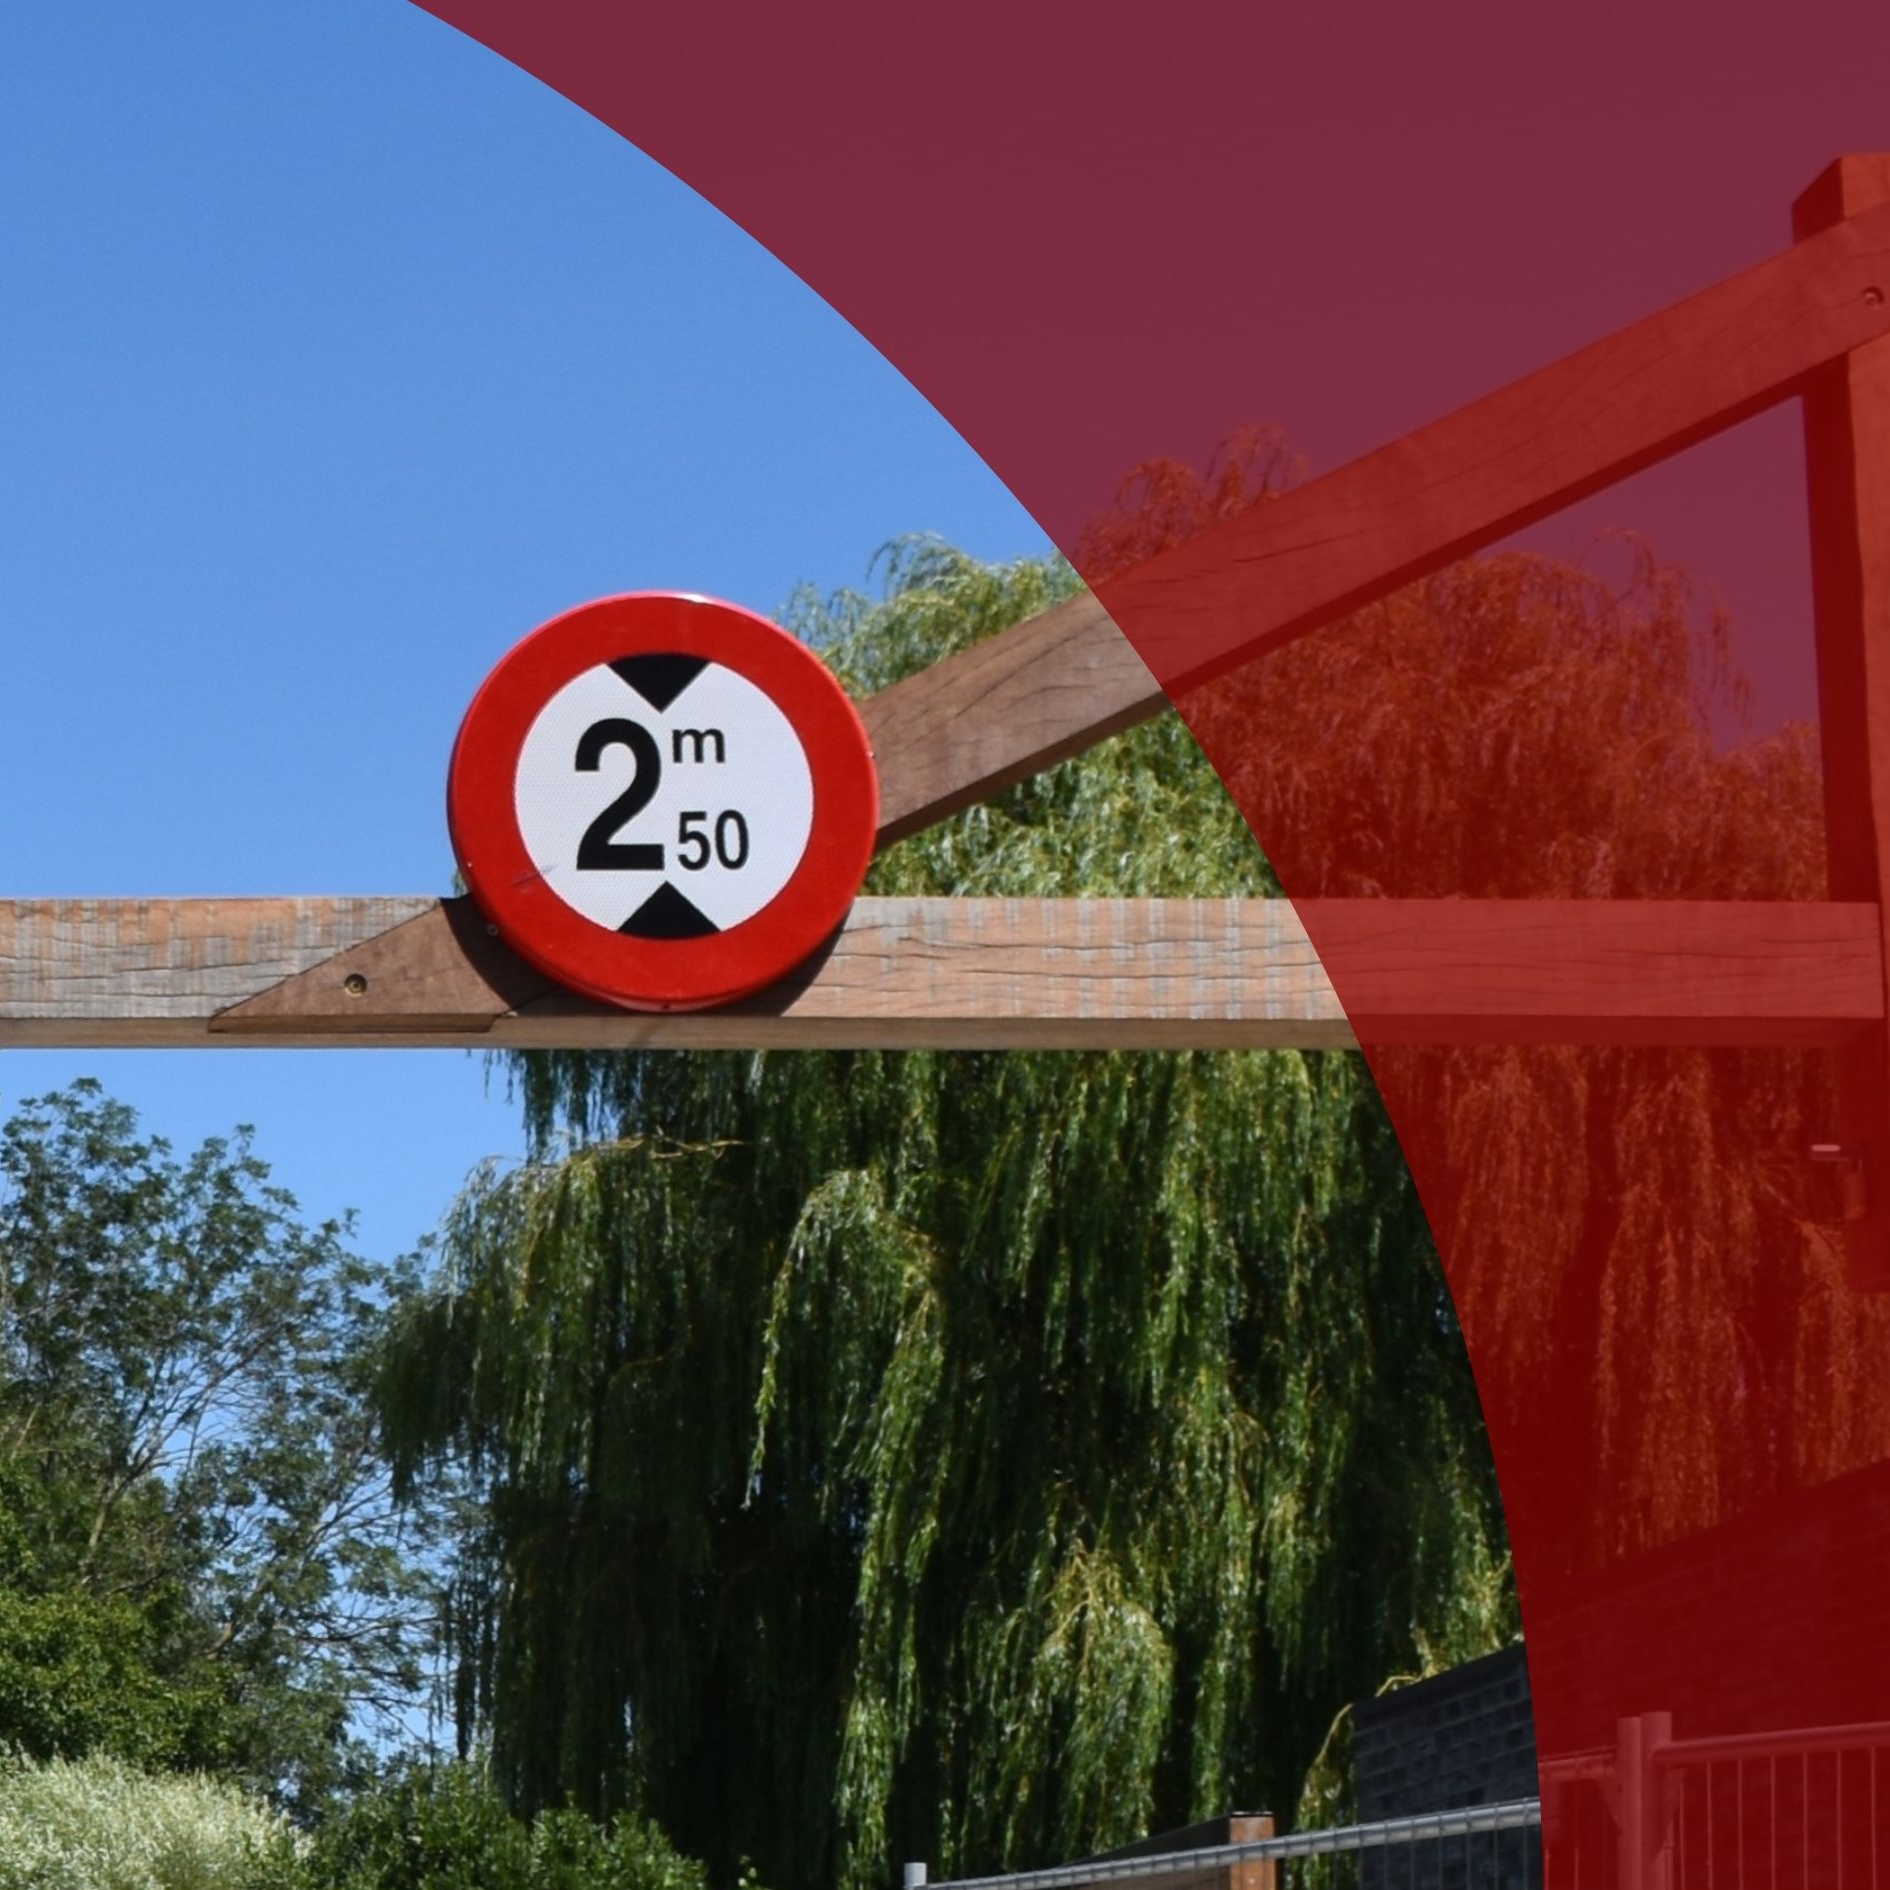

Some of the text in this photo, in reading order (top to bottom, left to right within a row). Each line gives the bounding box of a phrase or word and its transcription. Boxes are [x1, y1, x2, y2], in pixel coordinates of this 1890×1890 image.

[574, 717, 749, 871] 2 m 50
